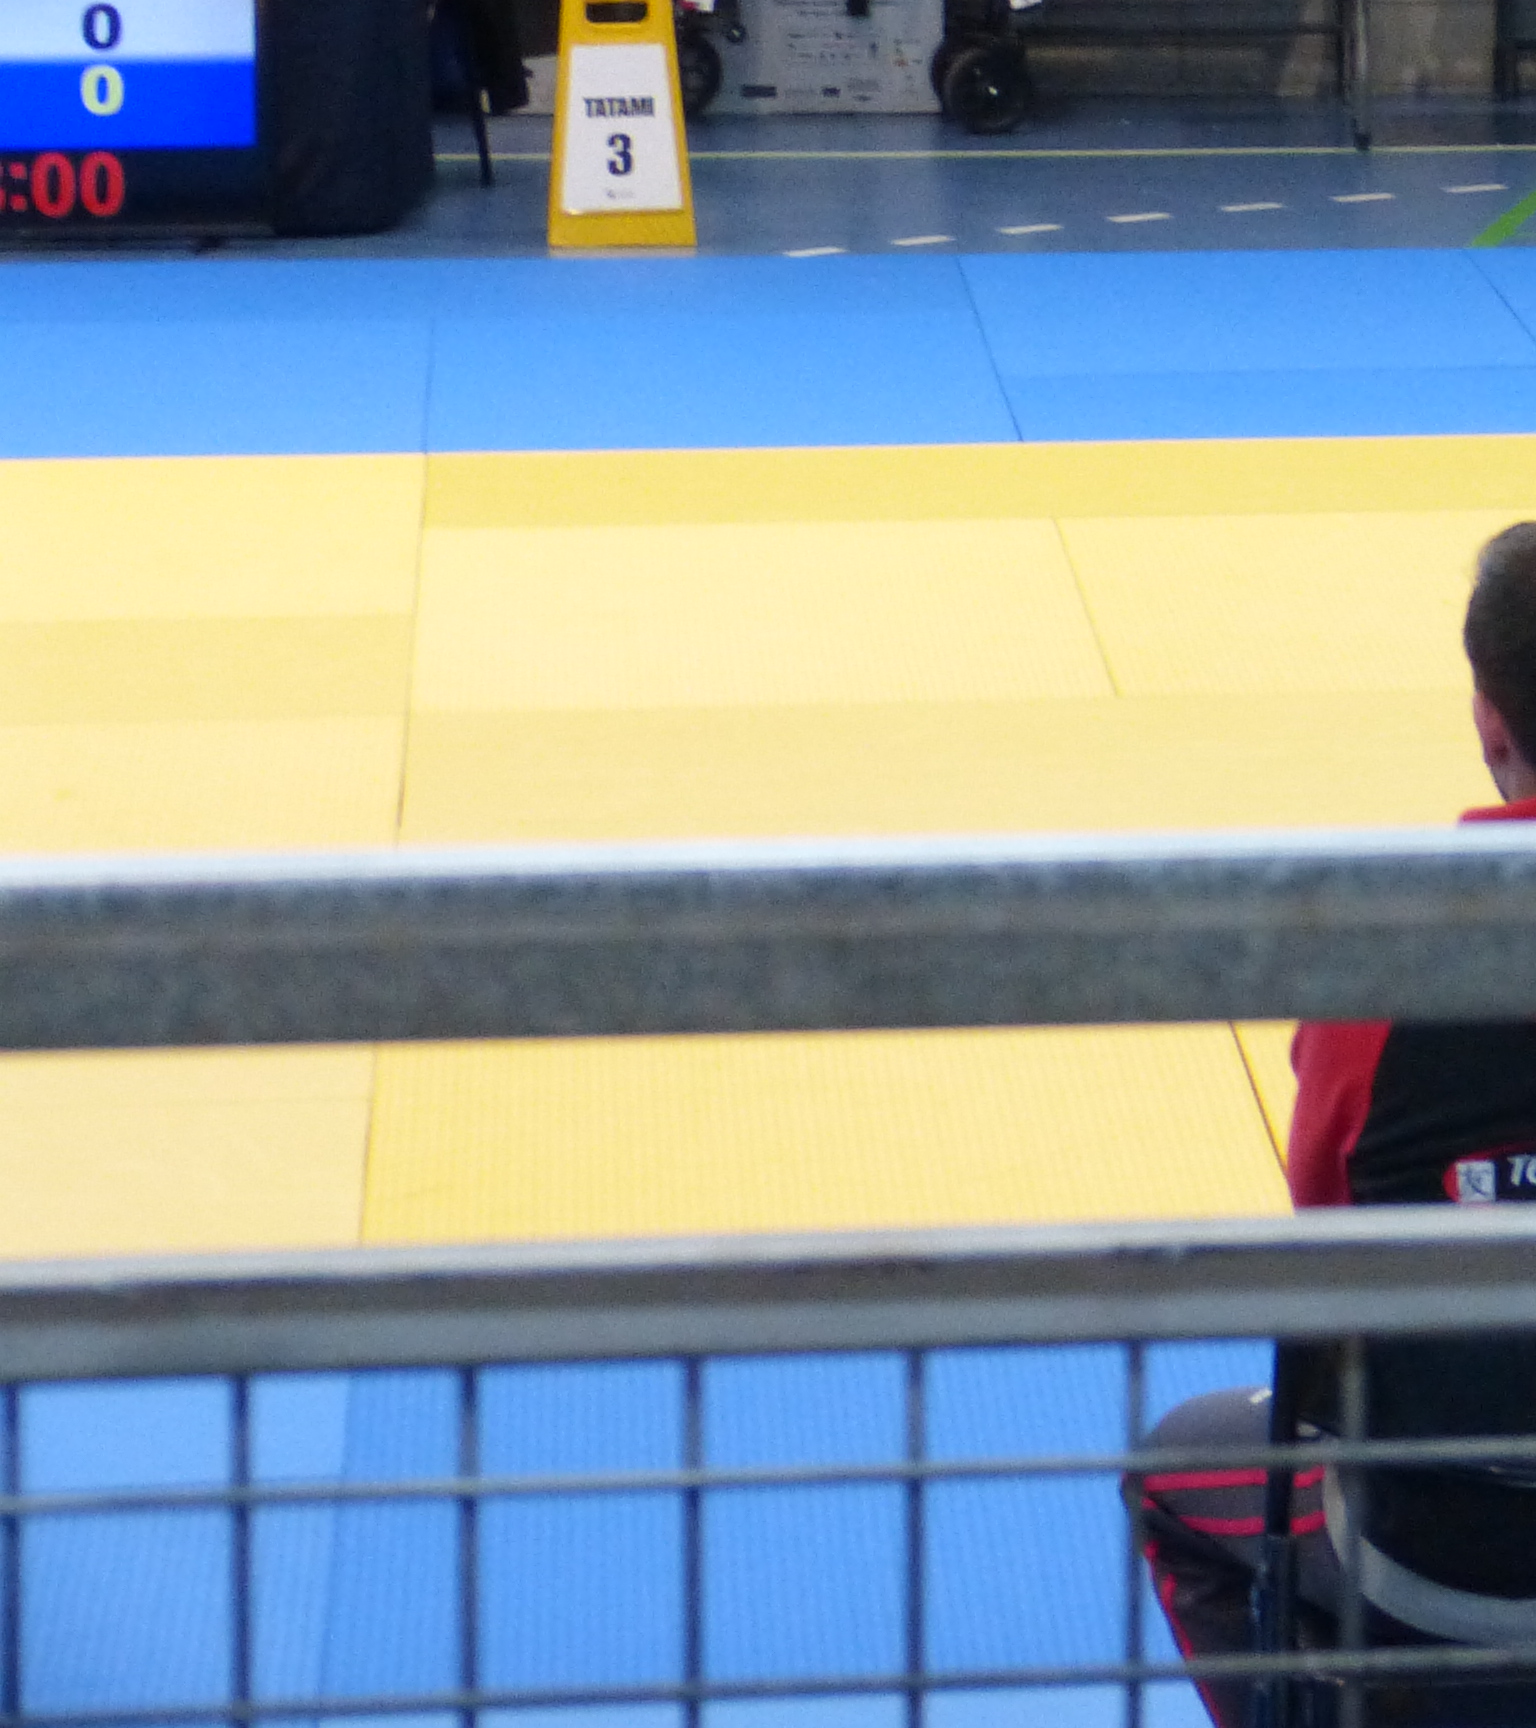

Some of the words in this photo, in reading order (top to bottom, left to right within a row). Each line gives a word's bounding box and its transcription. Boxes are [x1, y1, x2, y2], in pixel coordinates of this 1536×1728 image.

[82, 3, 122, 50] 0
[80, 64, 124, 115] 0
[583, 96, 655, 118] TATAMI
[607, 133, 632, 175] 3
[0, 151, 125, 217] :00
